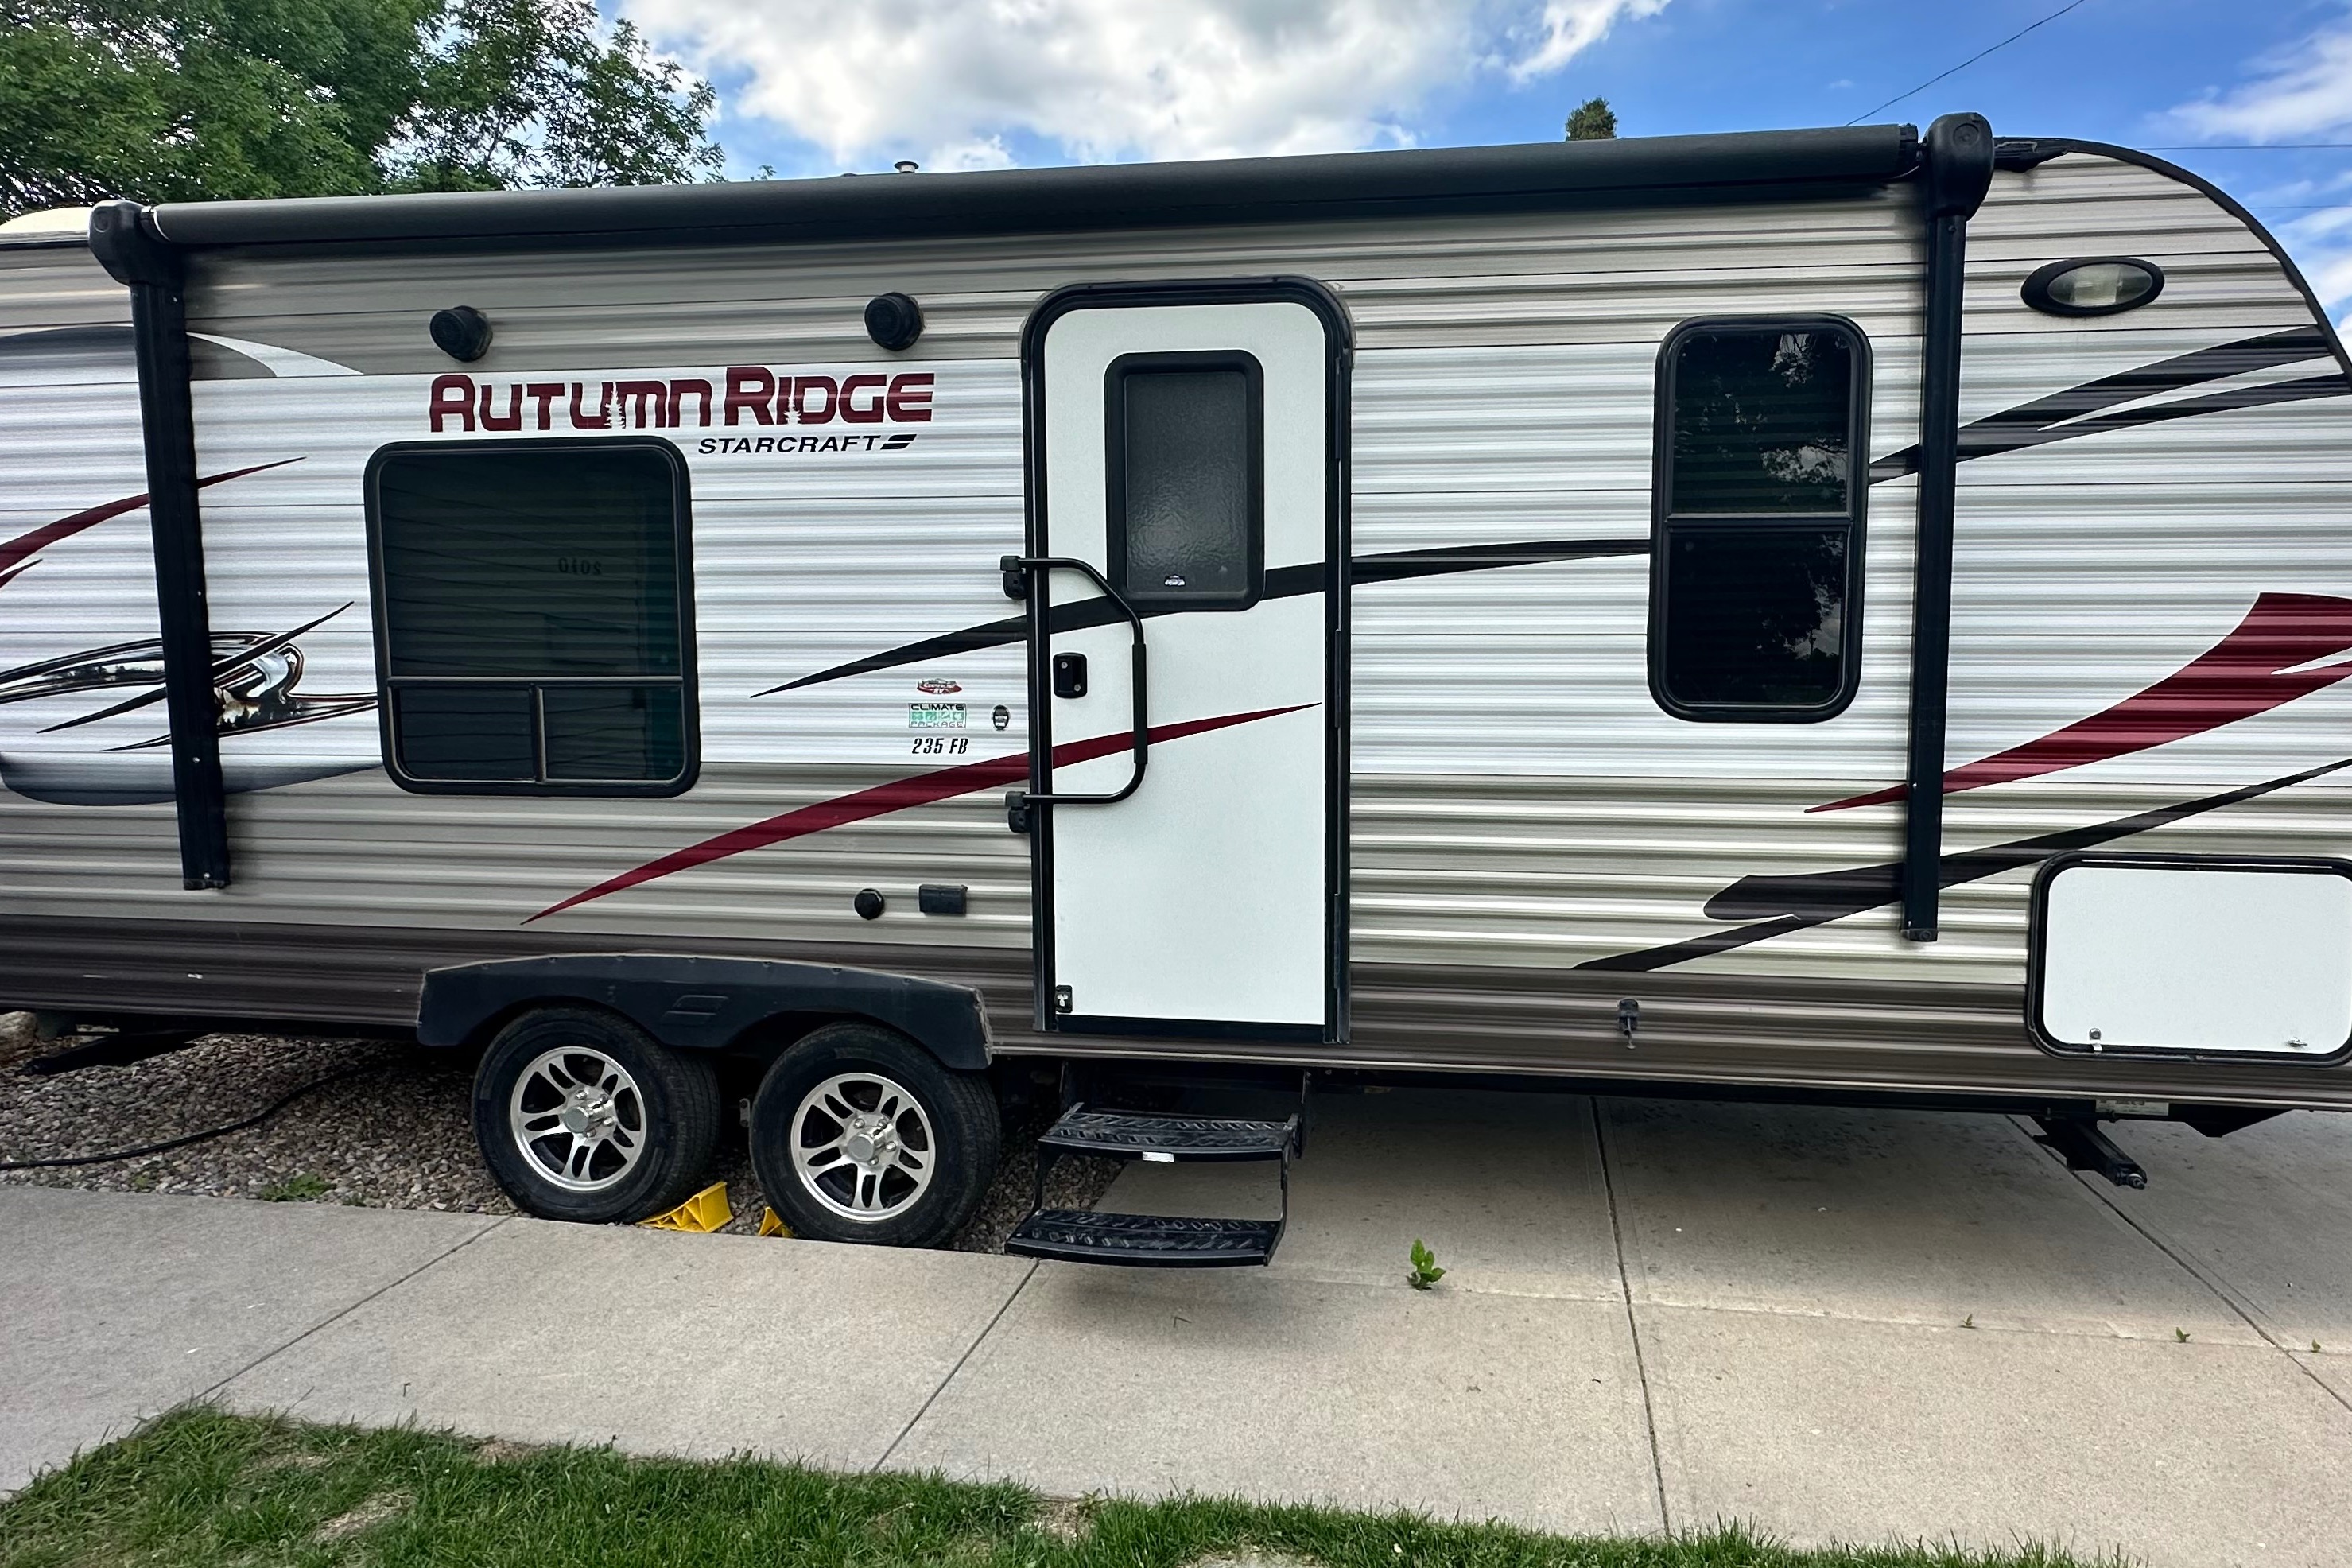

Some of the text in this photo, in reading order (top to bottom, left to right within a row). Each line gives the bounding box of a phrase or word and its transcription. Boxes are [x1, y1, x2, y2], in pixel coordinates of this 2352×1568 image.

[724, 367, 935, 427] RIDGE
[698, 434, 881, 454] STARCRAFT
[912, 738, 968, 755] 235 FB
